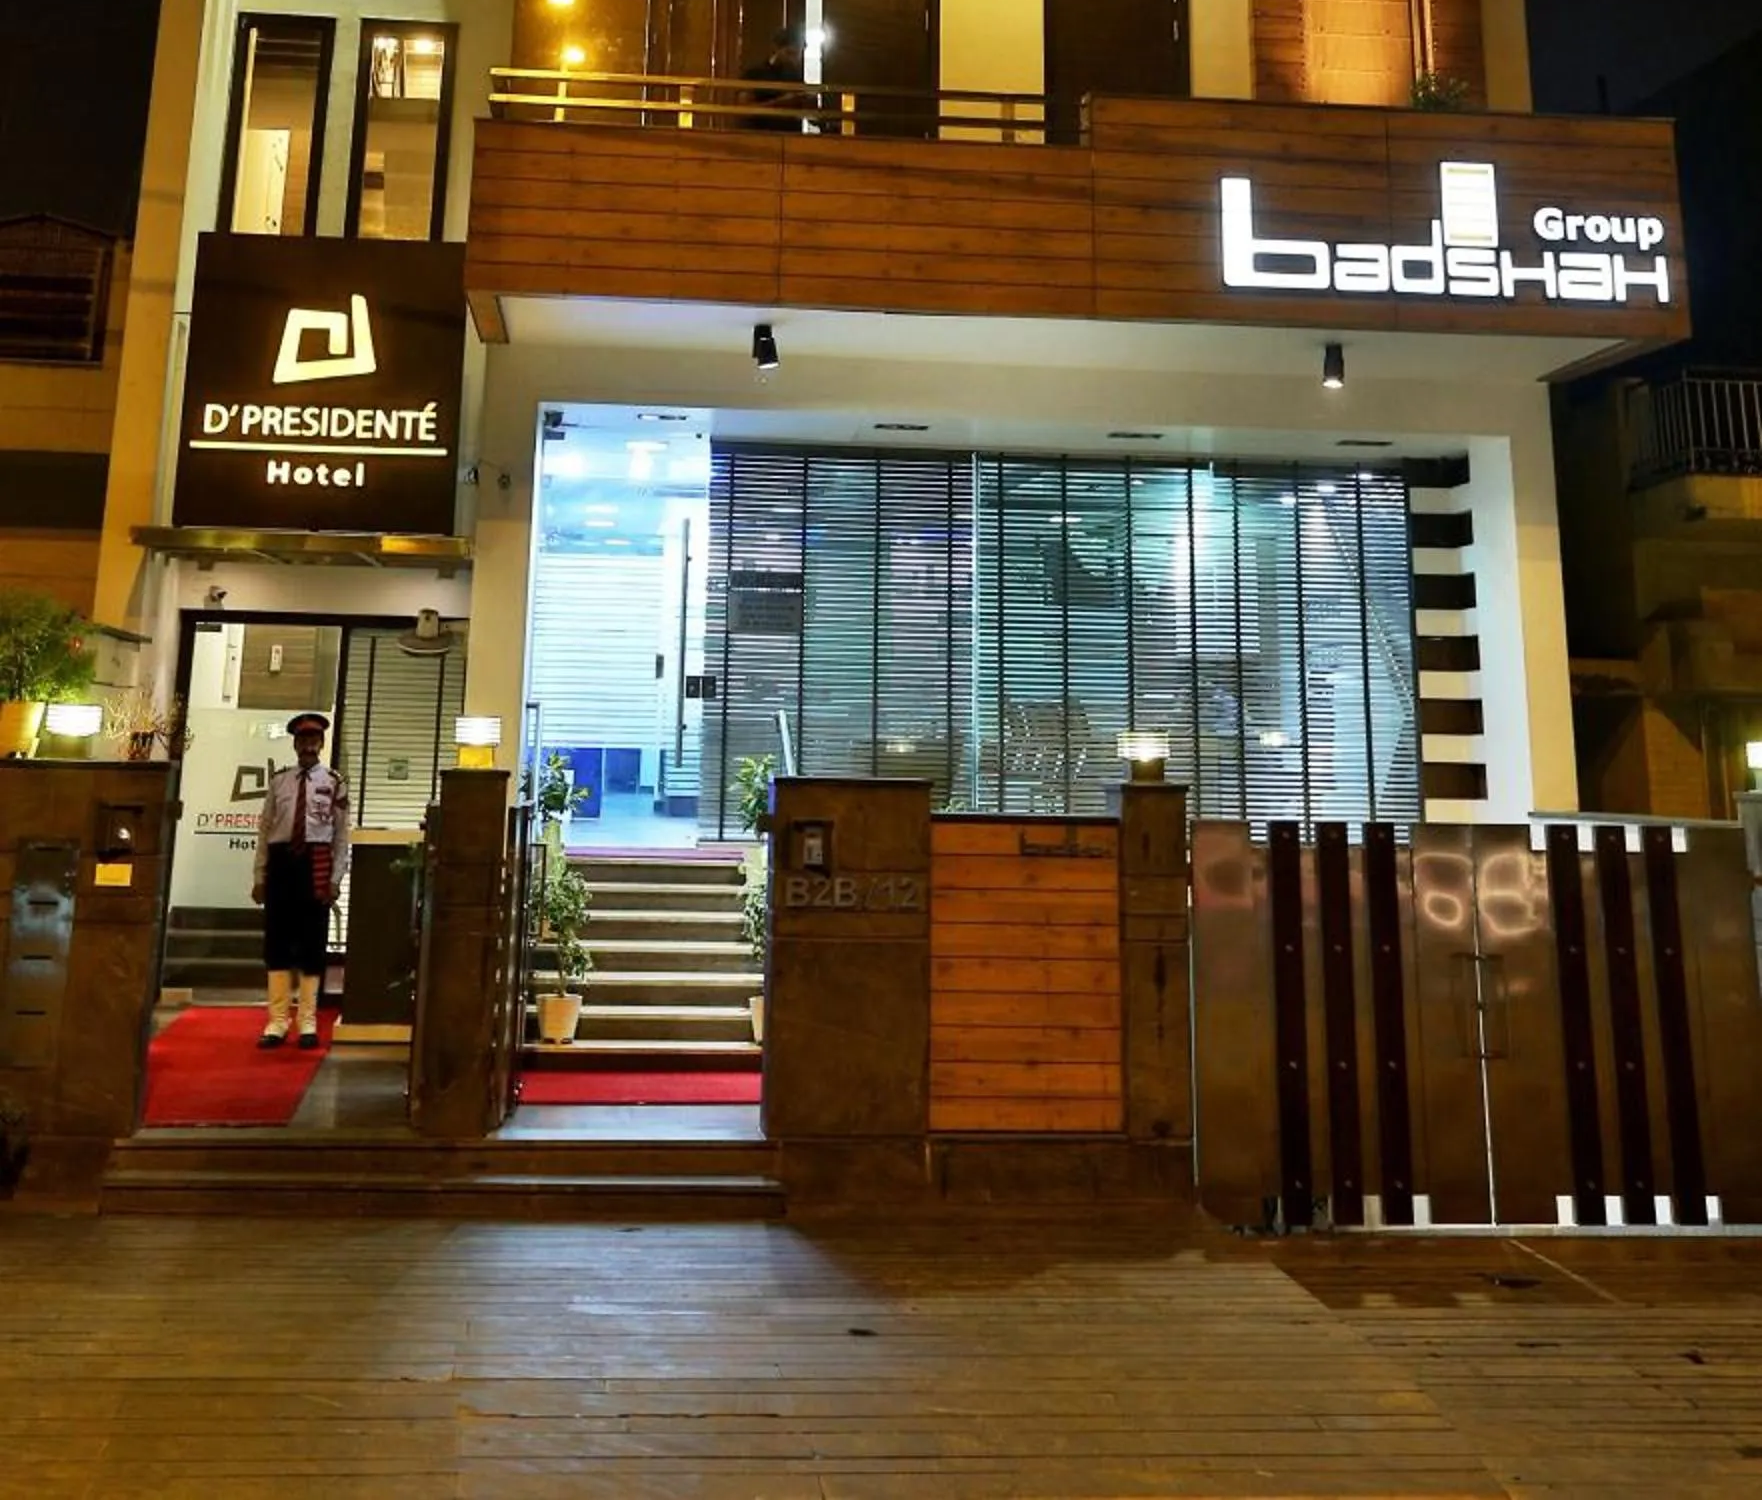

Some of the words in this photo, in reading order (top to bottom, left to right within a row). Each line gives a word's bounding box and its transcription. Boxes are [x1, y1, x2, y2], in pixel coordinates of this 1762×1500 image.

[1533, 207, 1664, 250] Group
[203, 402, 437, 441] D'PRESIDENTÉ
[266, 460, 365, 487] Hotel
[197, 813, 261, 829] D'PRESI
[229, 838, 257, 850] Hot
